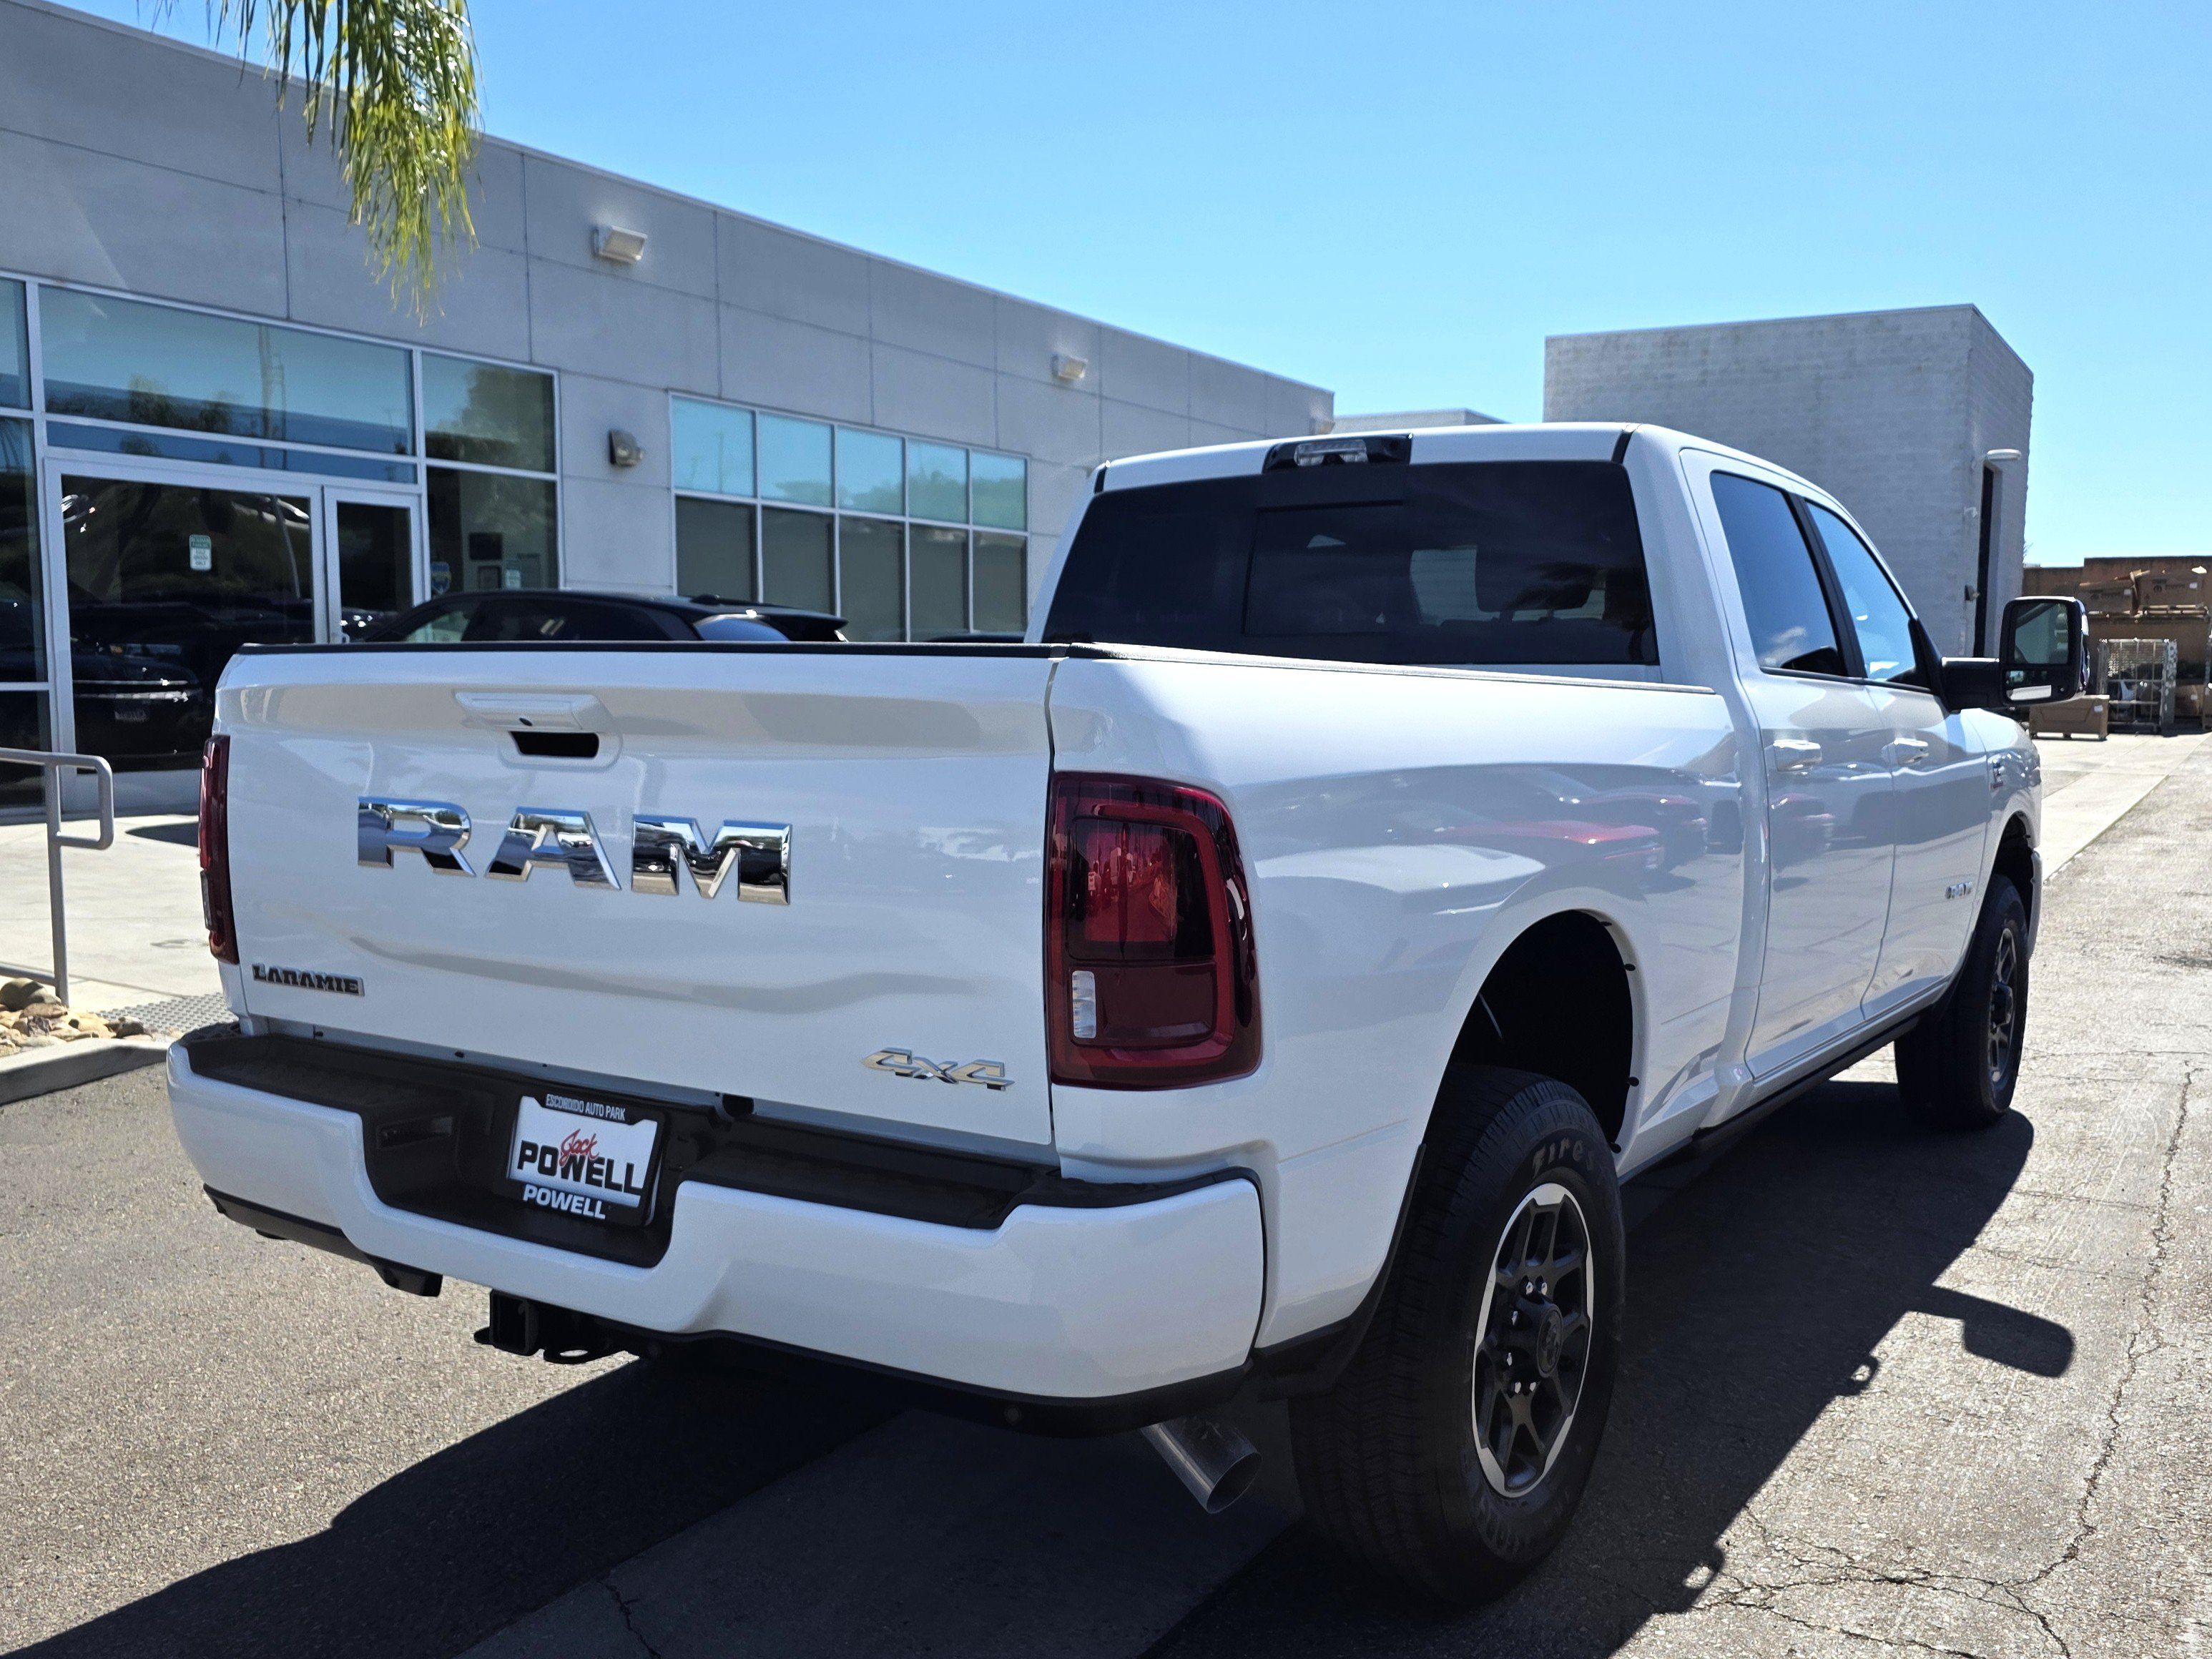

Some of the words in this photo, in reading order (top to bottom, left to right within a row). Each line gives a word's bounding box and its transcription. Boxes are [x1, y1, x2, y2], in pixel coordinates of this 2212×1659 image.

[358, 796, 792, 905] RAM
[252, 963, 365, 997] LARAMIE
[546, 1093, 584, 1113] ESCONDIDO
[585, 1102, 604, 1117] AUTO
[605, 1105, 626, 1121] PARK
[559, 1128, 599, 1168] Jack
[517, 1140, 644, 1197] POWELL
[523, 1183, 606, 1220] POWELL
